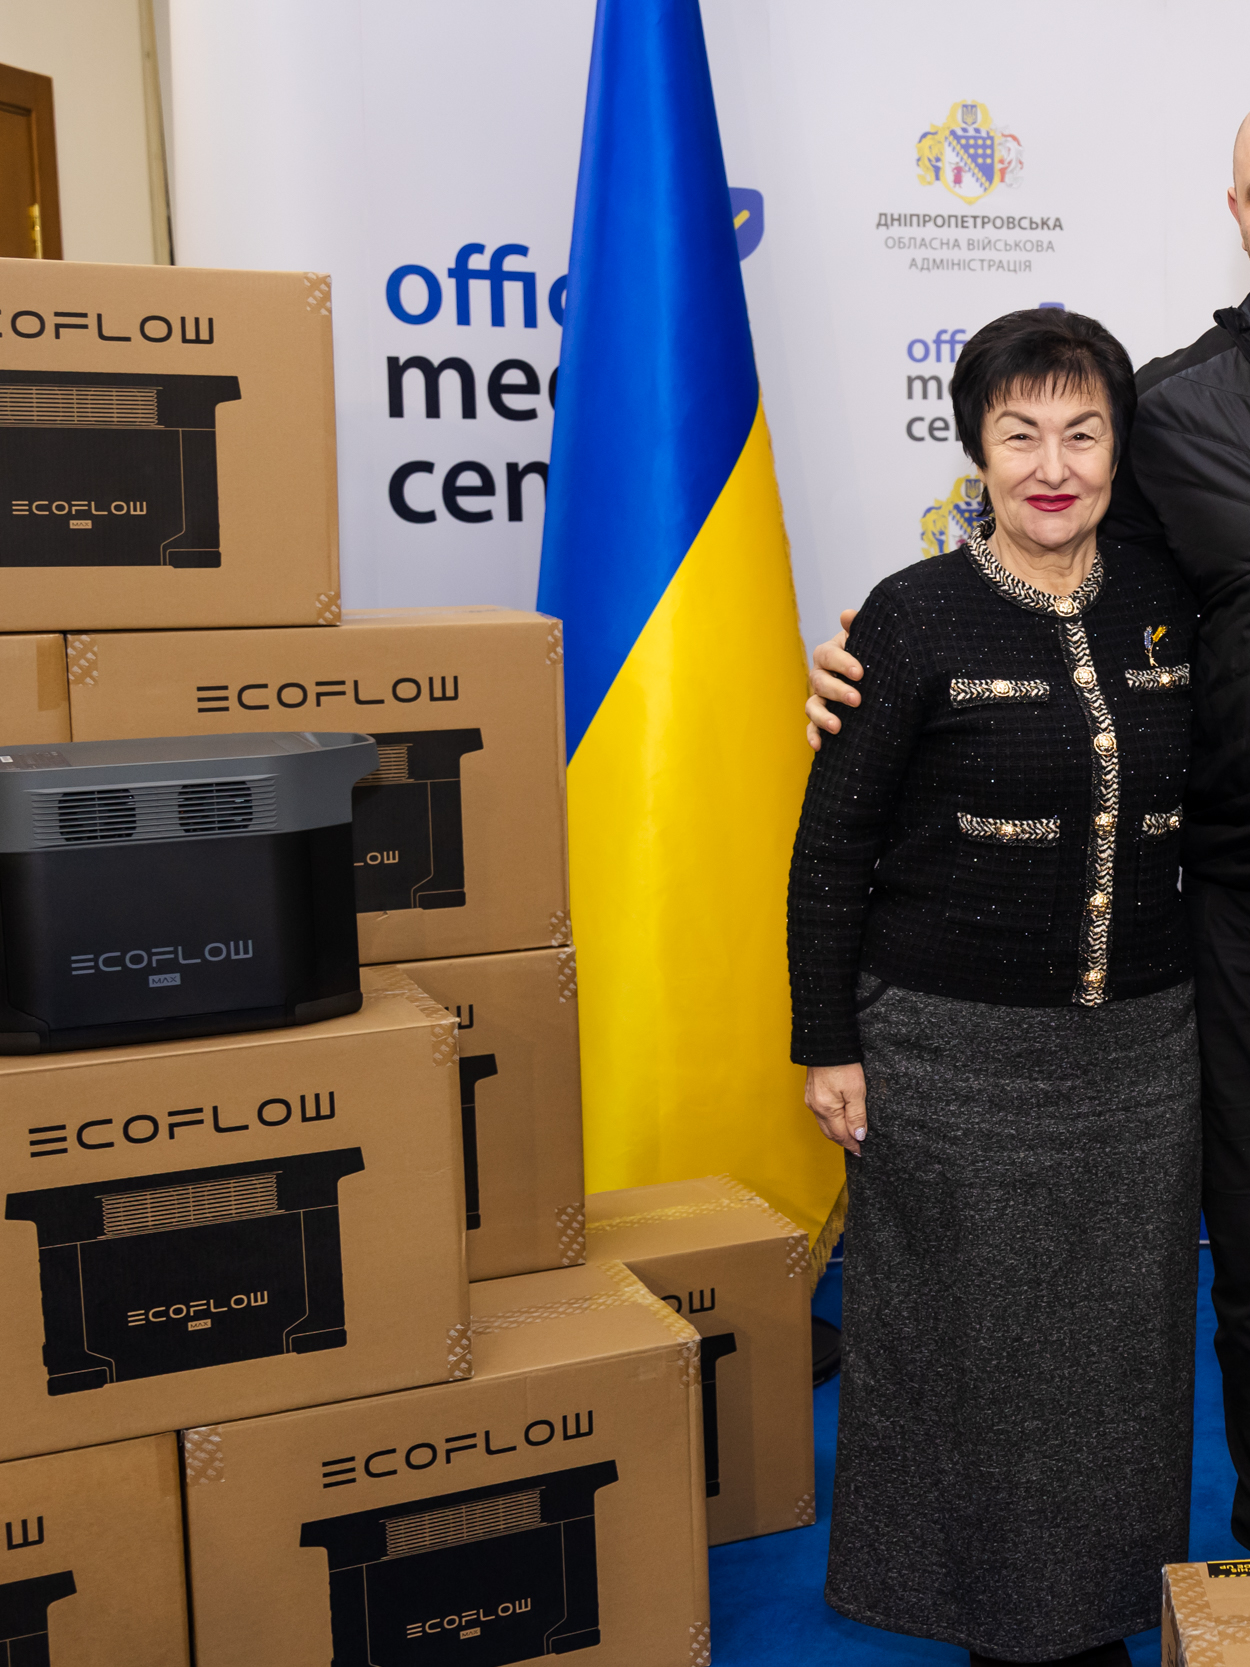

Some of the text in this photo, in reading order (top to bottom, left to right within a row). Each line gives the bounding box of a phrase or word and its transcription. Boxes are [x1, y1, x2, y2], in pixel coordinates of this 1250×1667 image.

[876, 212, 1064, 231] ДНІПРОПЕТРОВСЬКА
[885, 236, 1056, 253] ОБЛАСНА ВІЙСЬКОВА
[909, 257, 1032, 274] АДМІНІСТРАЦІЯ
[0, 309, 215, 345] OFLOW
[386, 355, 559, 422] me
[12, 500, 147, 515] ECOFLOW
[388, 460, 550, 524] cen
[196, 675, 459, 714] ECOFLOW
[70, 939, 254, 975] ECOFLOW
[151, 975, 178, 985] MAX
[28, 1090, 337, 1159] ECOFLOW
[127, 1290, 268, 1326] ECOFLOW
[321, 1409, 595, 1490] ECOFLOW
[406, 1597, 531, 1639] ECOFLOW
